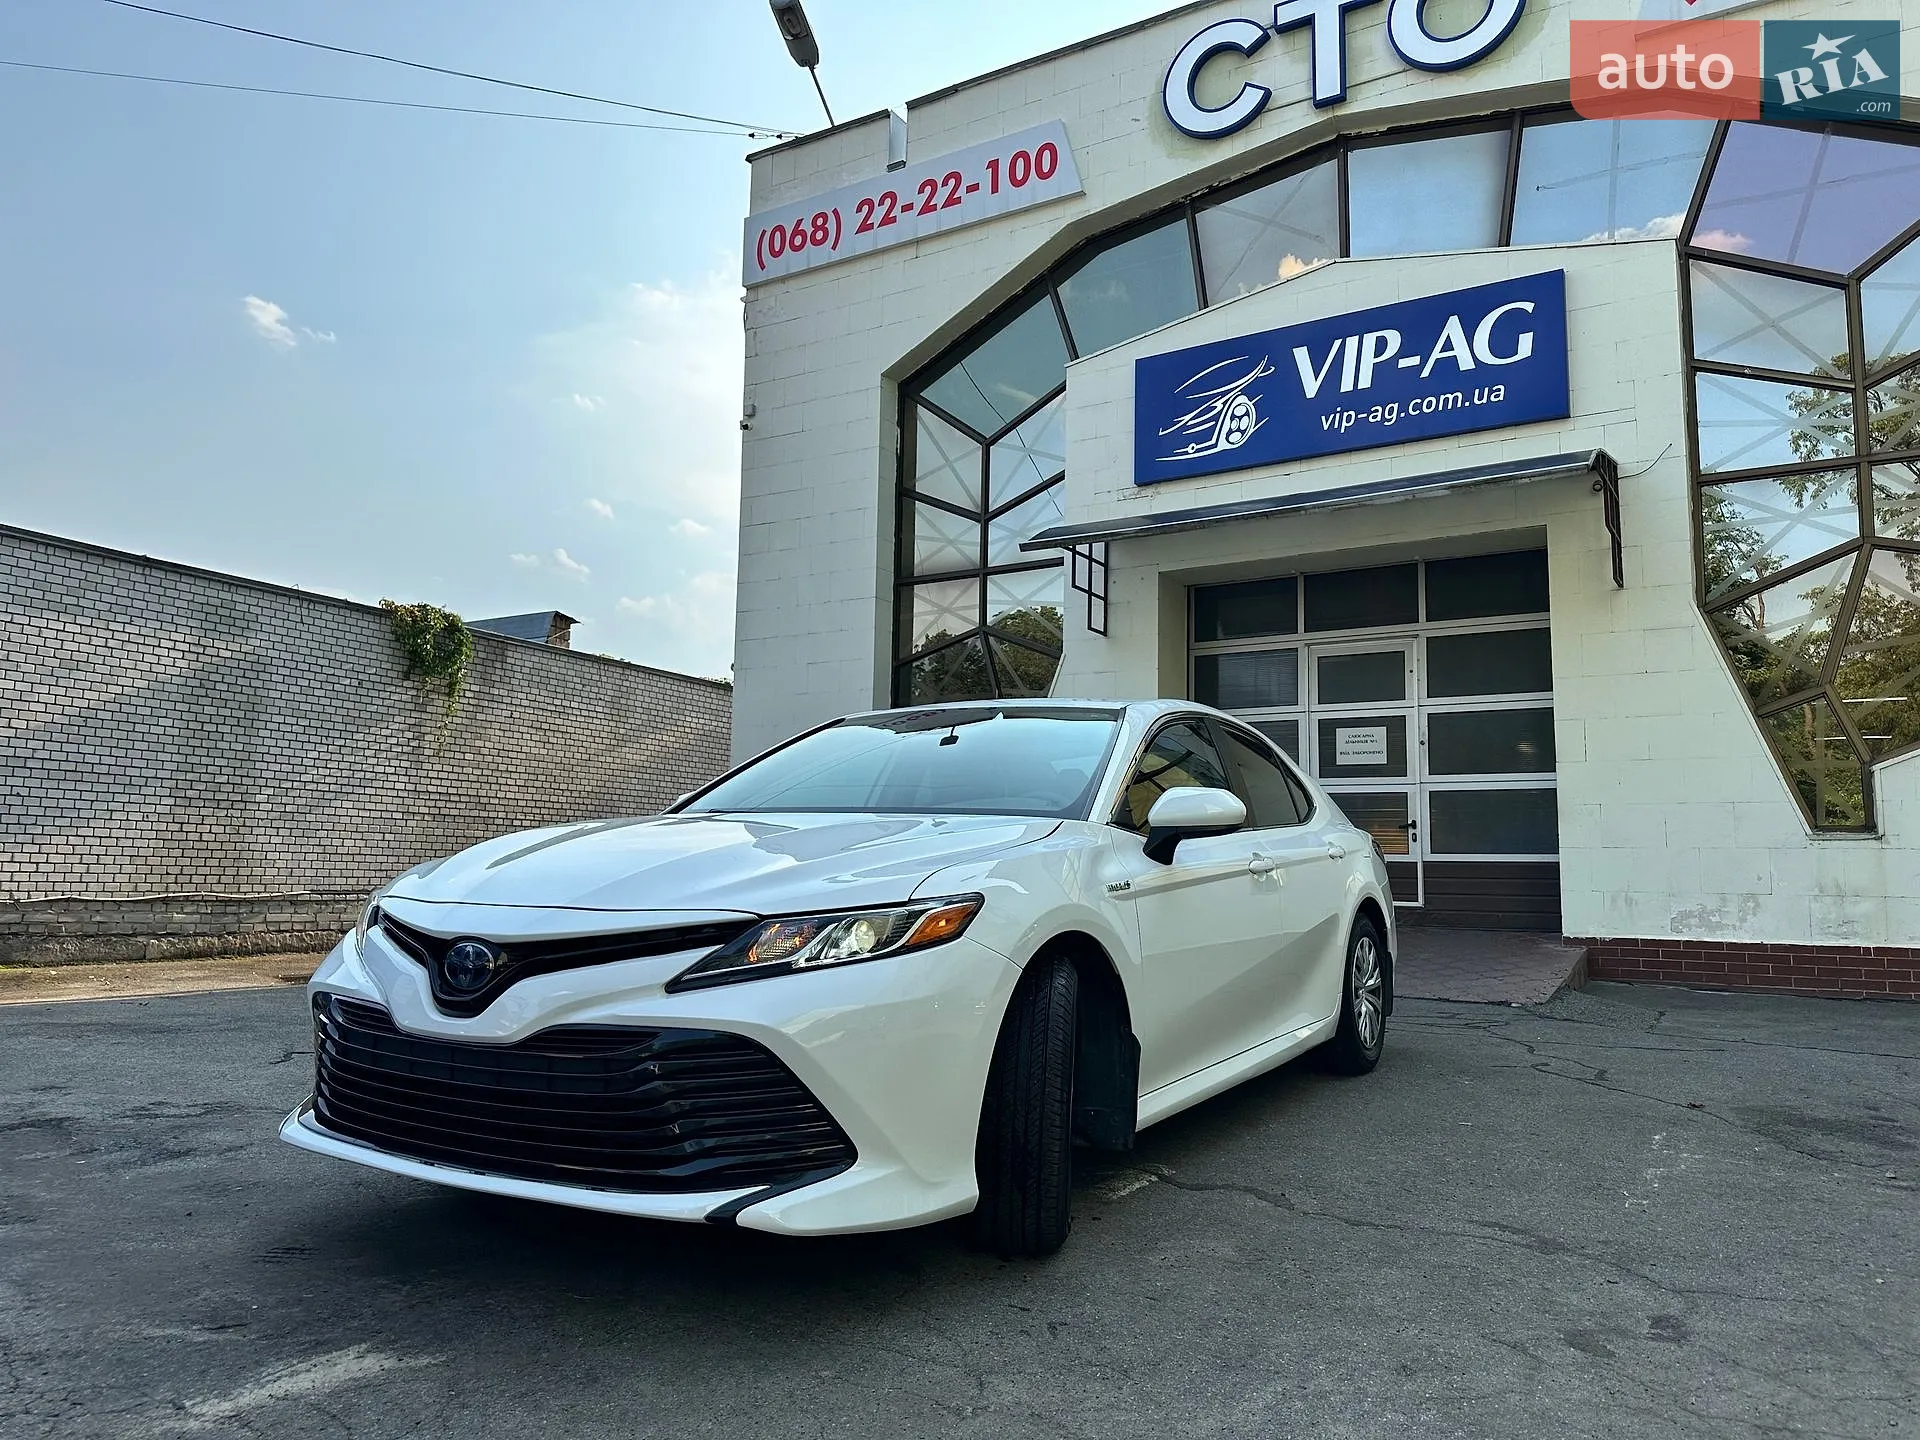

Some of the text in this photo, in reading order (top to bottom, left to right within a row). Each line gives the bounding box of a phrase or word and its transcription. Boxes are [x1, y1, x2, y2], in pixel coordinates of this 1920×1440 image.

[1163, 0, 1527, 139] СТО
[756, 141, 1060, 272] (068) 22-22-100
[1291, 301, 1536, 399] VIP-AG
[1320, 384, 1506, 433] vip-ag.com.ua
